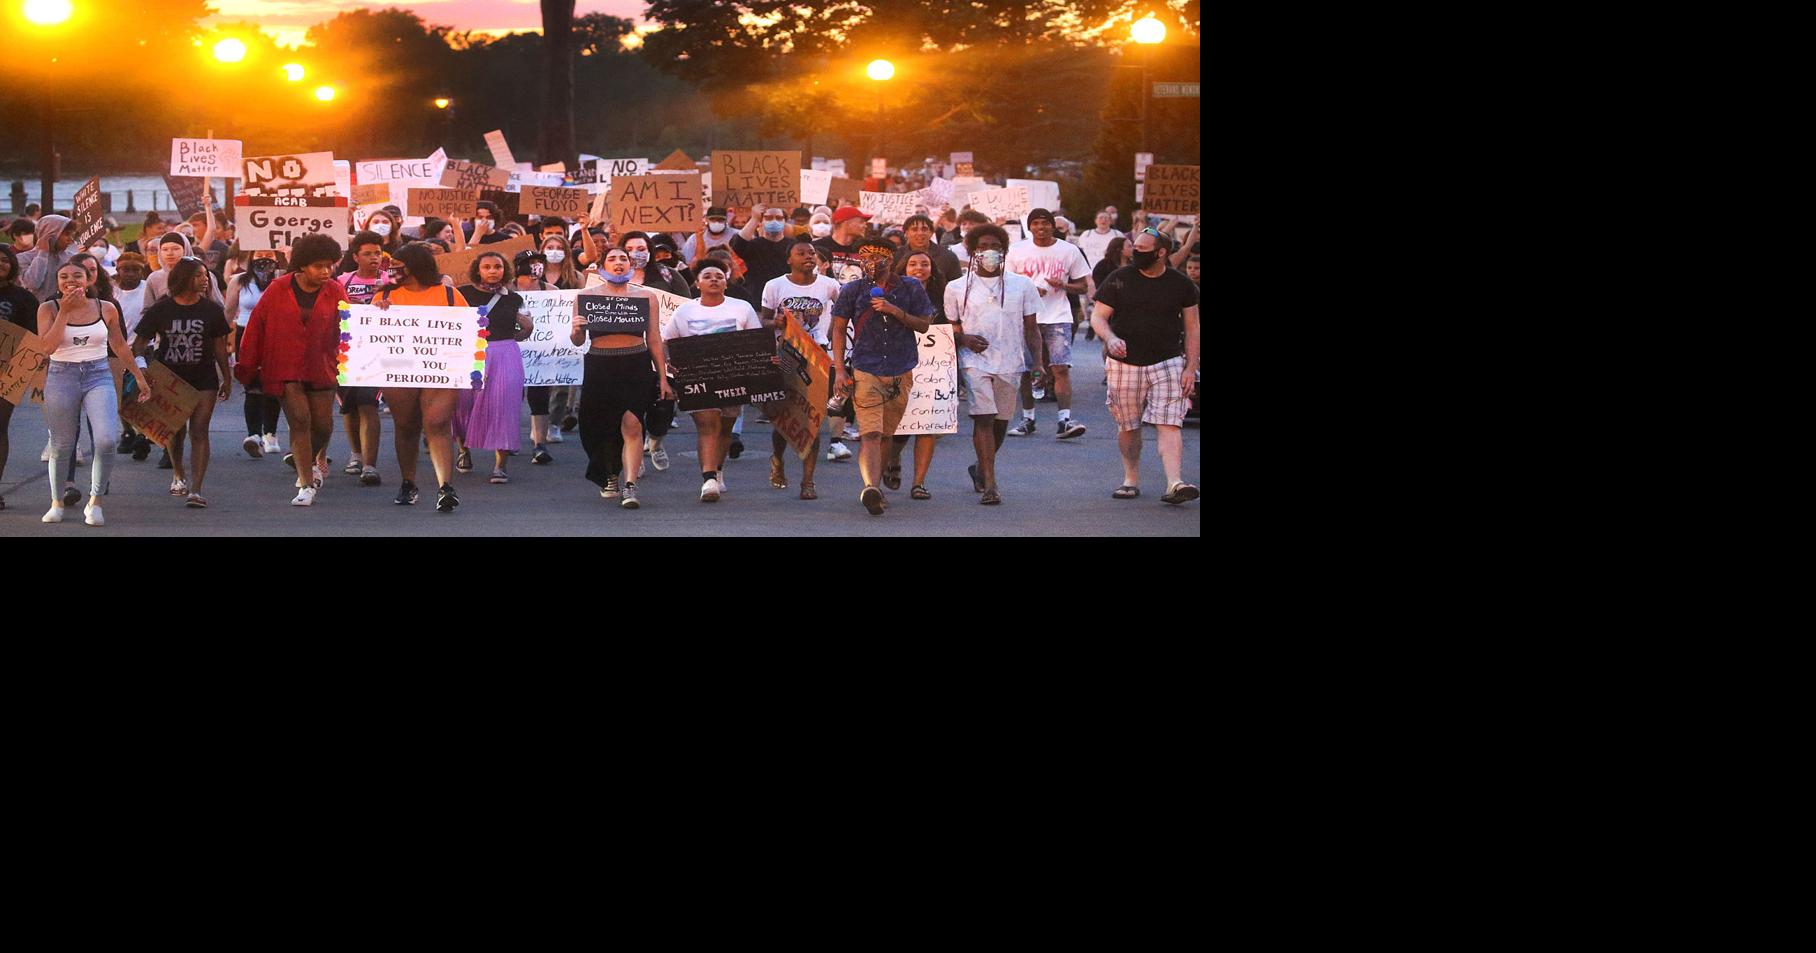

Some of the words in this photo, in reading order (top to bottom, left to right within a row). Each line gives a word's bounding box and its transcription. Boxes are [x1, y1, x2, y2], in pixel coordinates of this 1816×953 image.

[180, 142, 218, 154] Black
[179, 165, 218, 173] Matter
[247, 160, 301, 183] NO
[446, 160, 492, 178] BLACK
[612, 160, 638, 173] NO
[723, 154, 791, 175] BLACK
[363, 163, 432, 181] SILENCE
[1149, 167, 1200, 181] BLACK
[725, 176, 791, 191] LIVES
[1146, 183, 1199, 197] LIVES
[75, 181, 95, 204] WHITE
[418, 190, 435, 201] NO
[436, 189, 476, 201] JUSTICE
[532, 187, 581, 200] GEORGE
[620, 181, 660, 202] AM
[668, 180, 693, 200] I
[723, 190, 798, 206] MATTER
[77, 190, 98, 217] SILENCE
[274, 197, 307, 208] ACAB
[535, 200, 578, 212] FLOYD
[879, 193, 914, 205] JUSTICE
[1144, 198, 1200, 212] MATTER
[418, 203, 434, 213] NO
[621, 203, 696, 226] NEXT?
[84, 211, 91, 224] IS
[249, 210, 334, 232] Goerge
[585, 301, 611, 311] Closed
[615, 303, 639, 311] Minds
[782, 297, 821, 311] Queen
[359, 316, 372, 326] IF
[379, 317, 420, 327] BLACK
[427, 319, 463, 331] LIVES
[587, 314, 612, 324] Closed
[165, 320, 204, 334] JUS
[168, 333, 203, 347] TAG
[369, 334, 405, 344] DONT
[412, 335, 463, 347] MATTER
[387, 346, 405, 355] TO
[413, 346, 438, 356] YOU
[422, 360, 448, 371] YOU
[386, 373, 450, 385] PERIODDD
[684, 382, 707, 396] SAY
[714, 386, 747, 399] THEIR
[750, 391, 786, 403] NAMES
[934, 389, 956, 401] But
